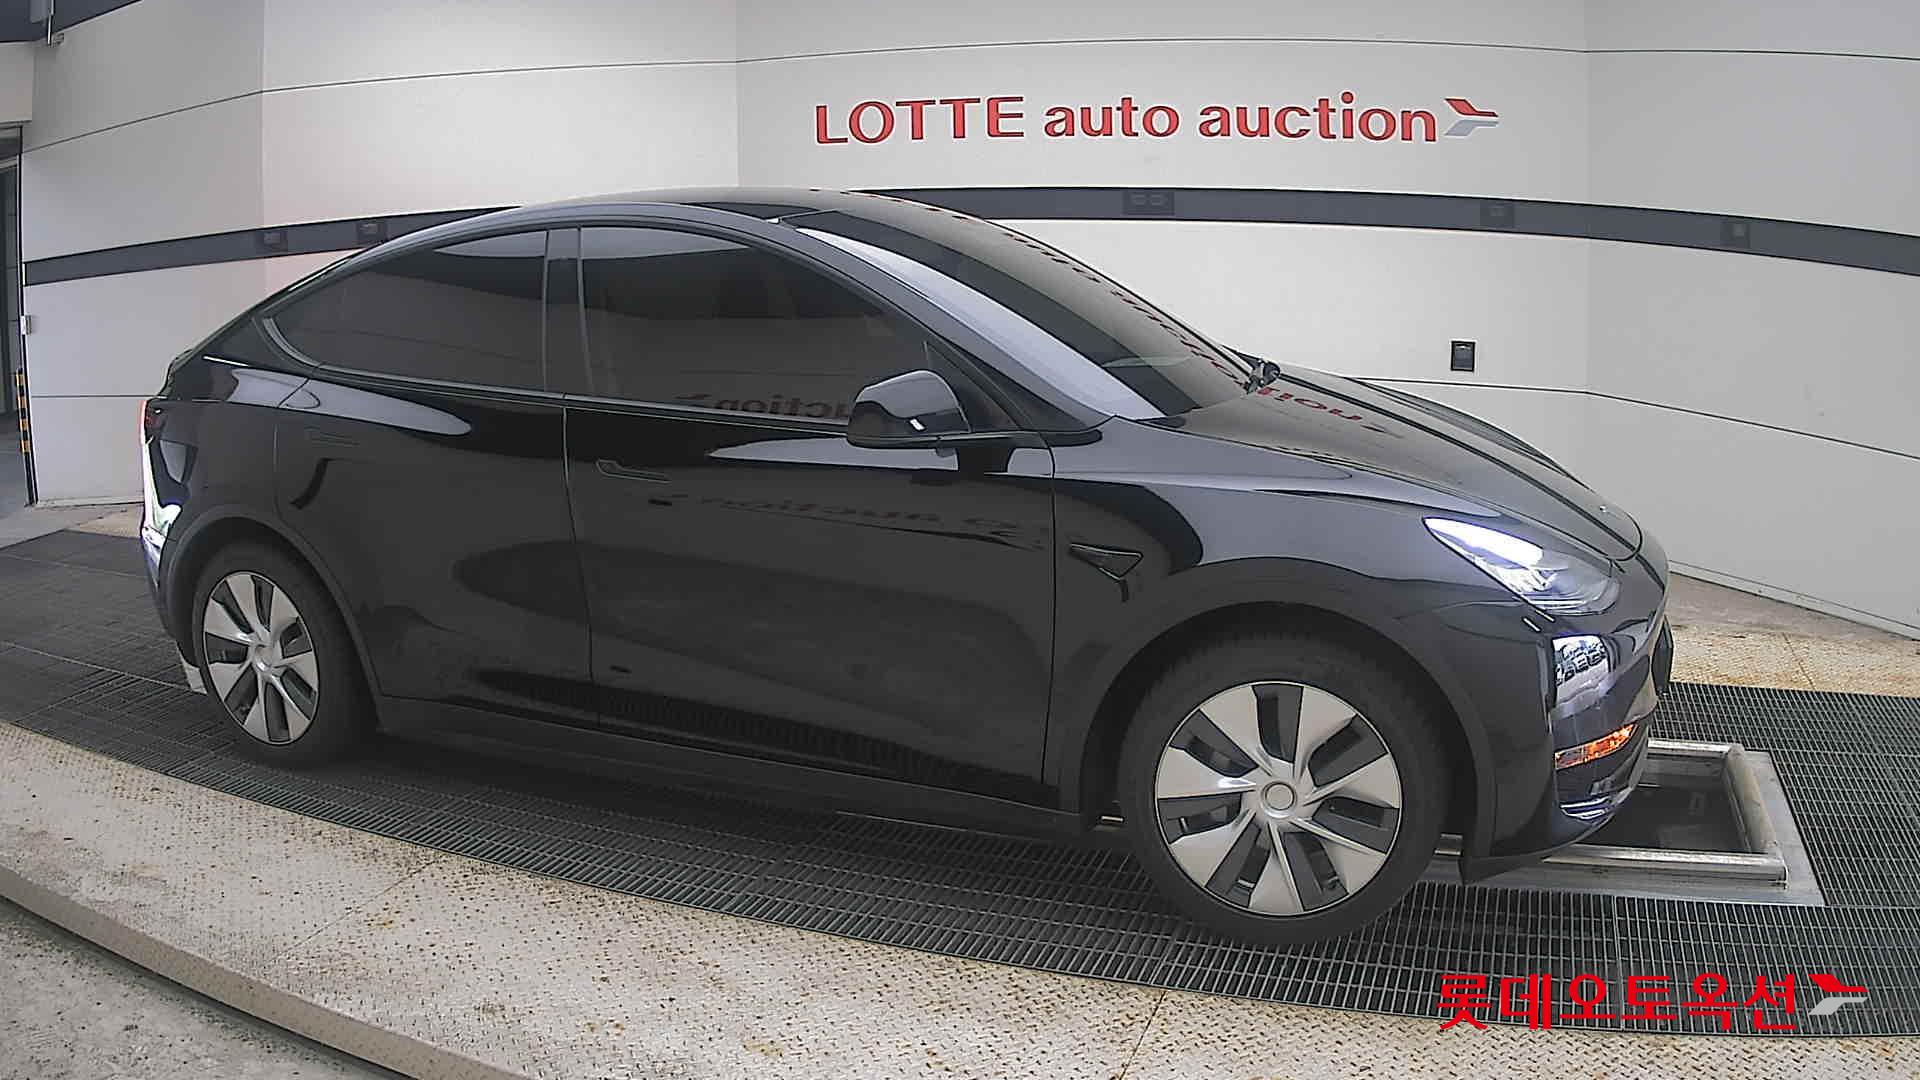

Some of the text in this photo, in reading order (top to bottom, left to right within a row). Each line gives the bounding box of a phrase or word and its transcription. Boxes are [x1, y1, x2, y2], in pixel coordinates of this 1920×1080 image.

[815, 91, 1438, 144] LOTTE auto auction
